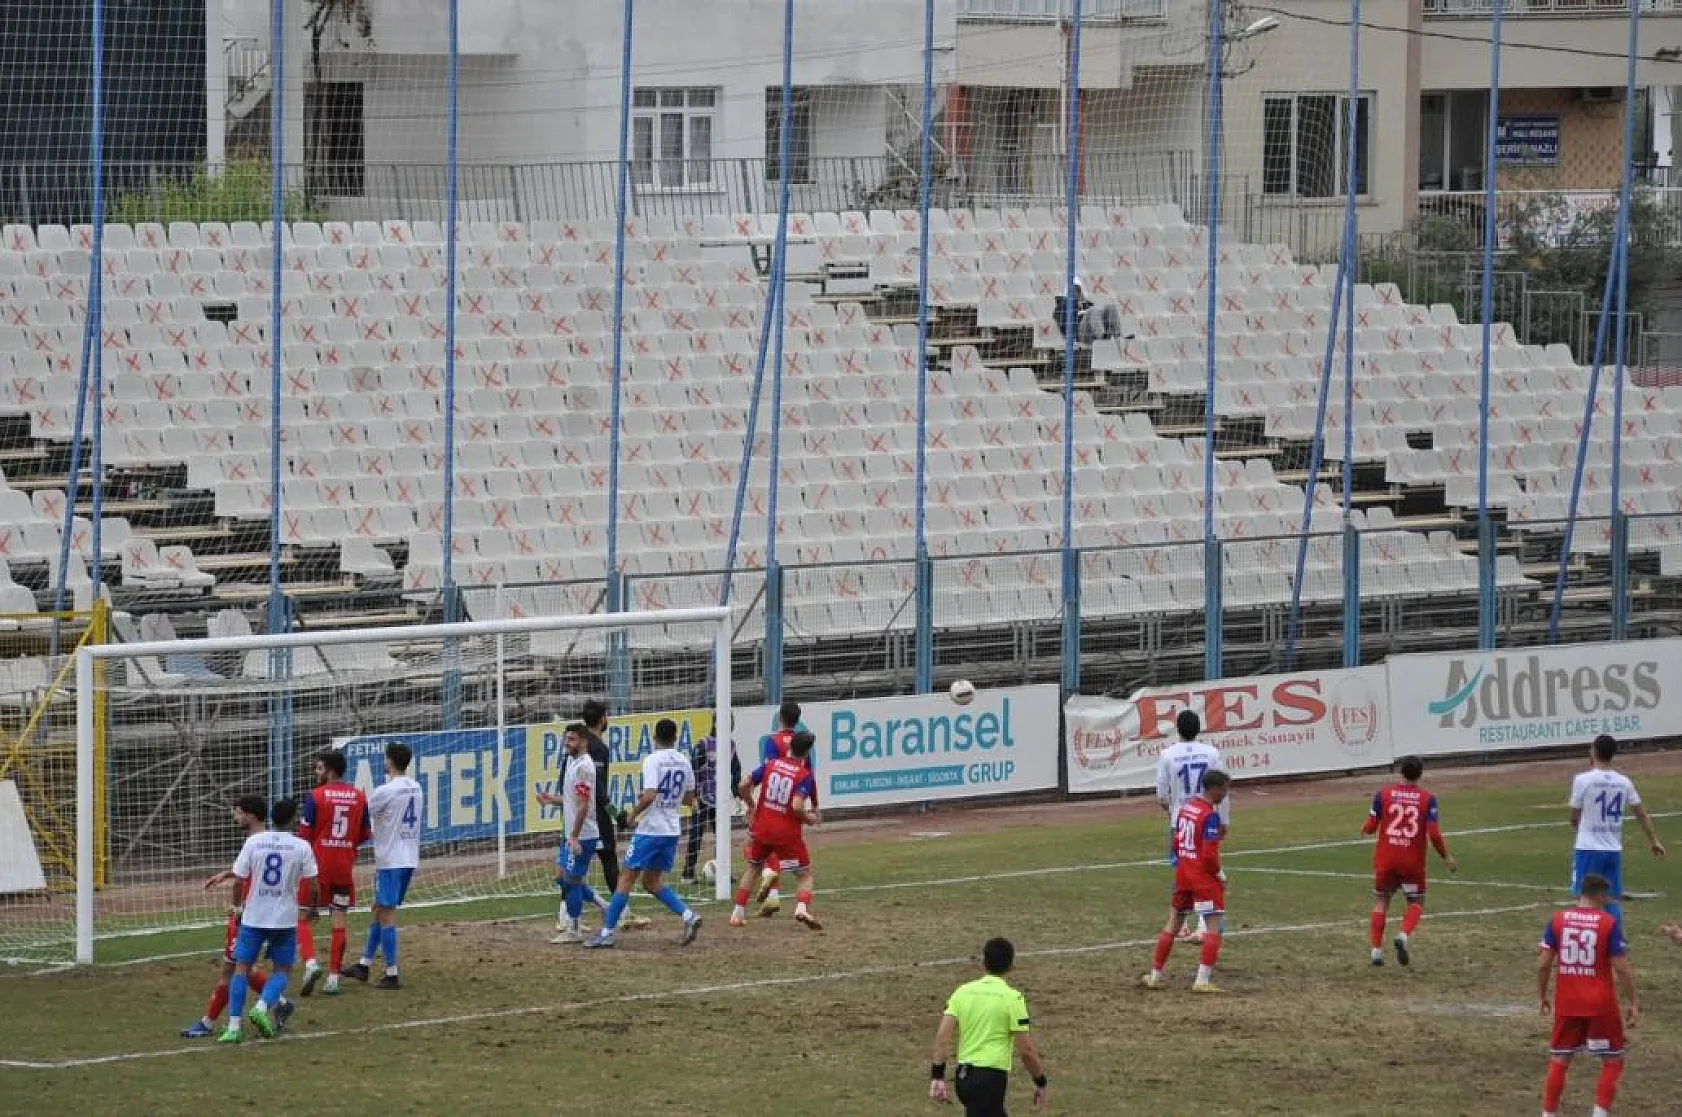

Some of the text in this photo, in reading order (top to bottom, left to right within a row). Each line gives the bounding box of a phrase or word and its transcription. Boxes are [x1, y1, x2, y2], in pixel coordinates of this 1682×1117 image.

[1428, 655, 1662, 728] Address
[1128, 678, 1327, 741] FES
[831, 698, 1014, 760] Baransel
[1479, 723, 1563, 743] RESTAURANT
[1566, 721, 1600, 736] CAFE
[1613, 716, 1641, 732] BAR
[657, 769, 685, 800] 48
[968, 761, 1015, 784] GRUP
[1177, 761, 1209, 794] 17
[331, 805, 350, 838] 5
[402, 795, 418, 829] 4
[1386, 803, 1419, 838] 23
[1594, 790, 1623, 822] 14
[263, 852, 283, 887] 8
[1560, 927, 1598, 965] 53
